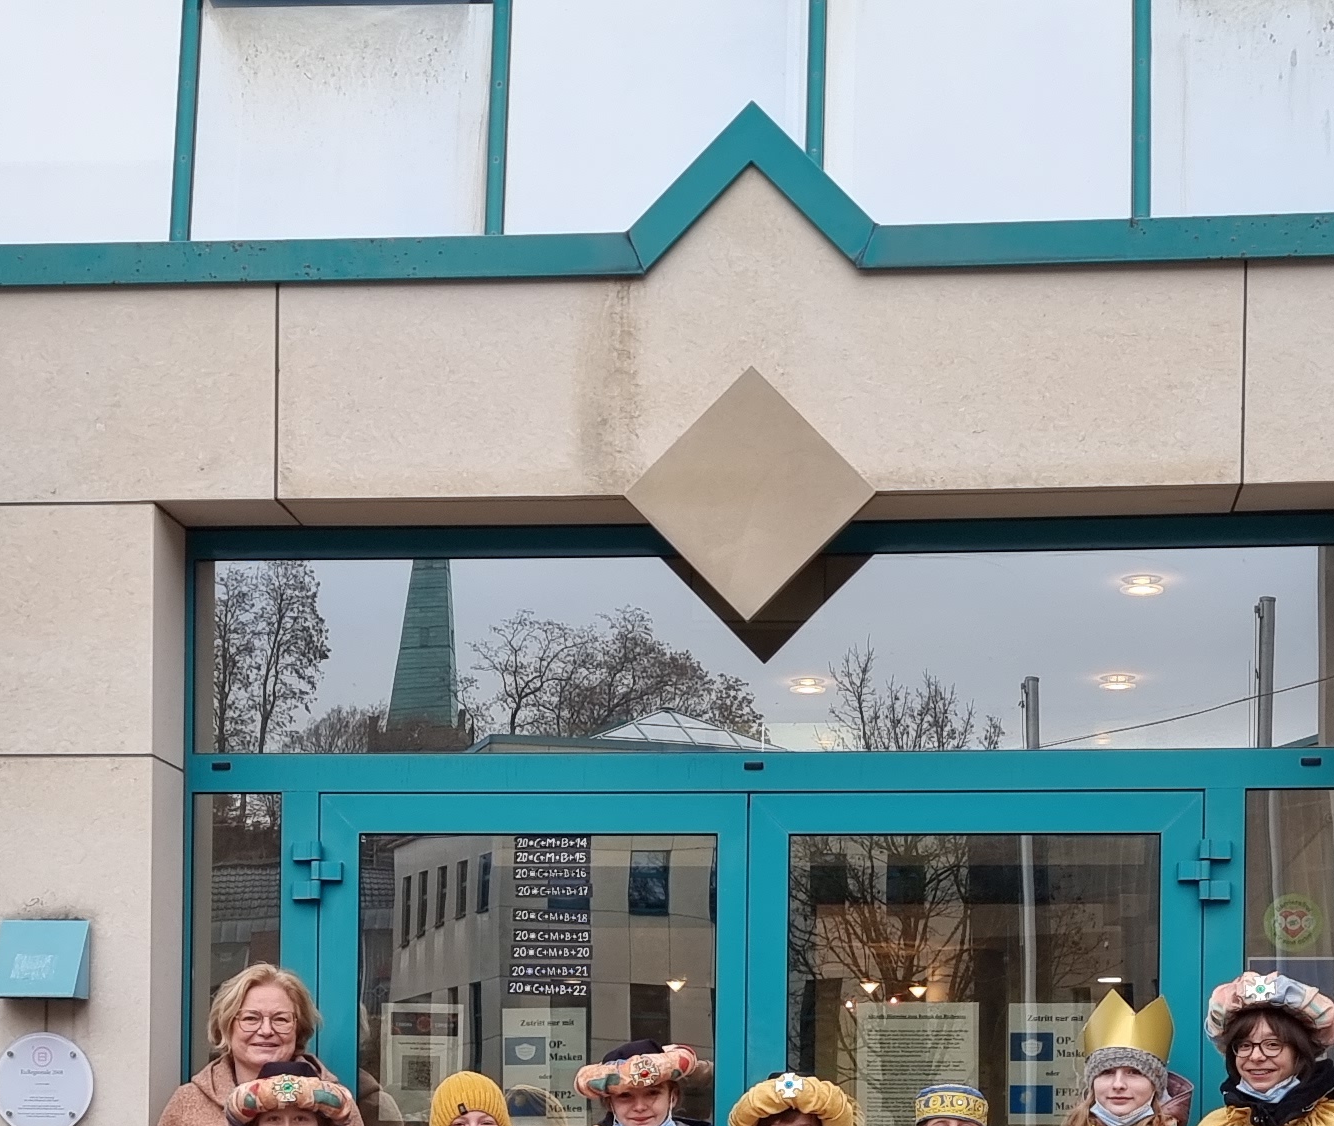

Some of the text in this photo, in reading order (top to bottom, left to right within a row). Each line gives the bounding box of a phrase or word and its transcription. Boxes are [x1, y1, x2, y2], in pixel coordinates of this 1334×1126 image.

[1027, 1014, 1053, 1022] Zutritt
[520, 1019, 545, 1027] Zutritt
[549, 1040, 566, 1049] OP-
[1056, 1036, 1075, 1045] OP-
[549, 1053, 583, 1061] Masken
[1056, 1049, 1086, 1058] Maske
[548, 1104, 583, 1113] Masken
